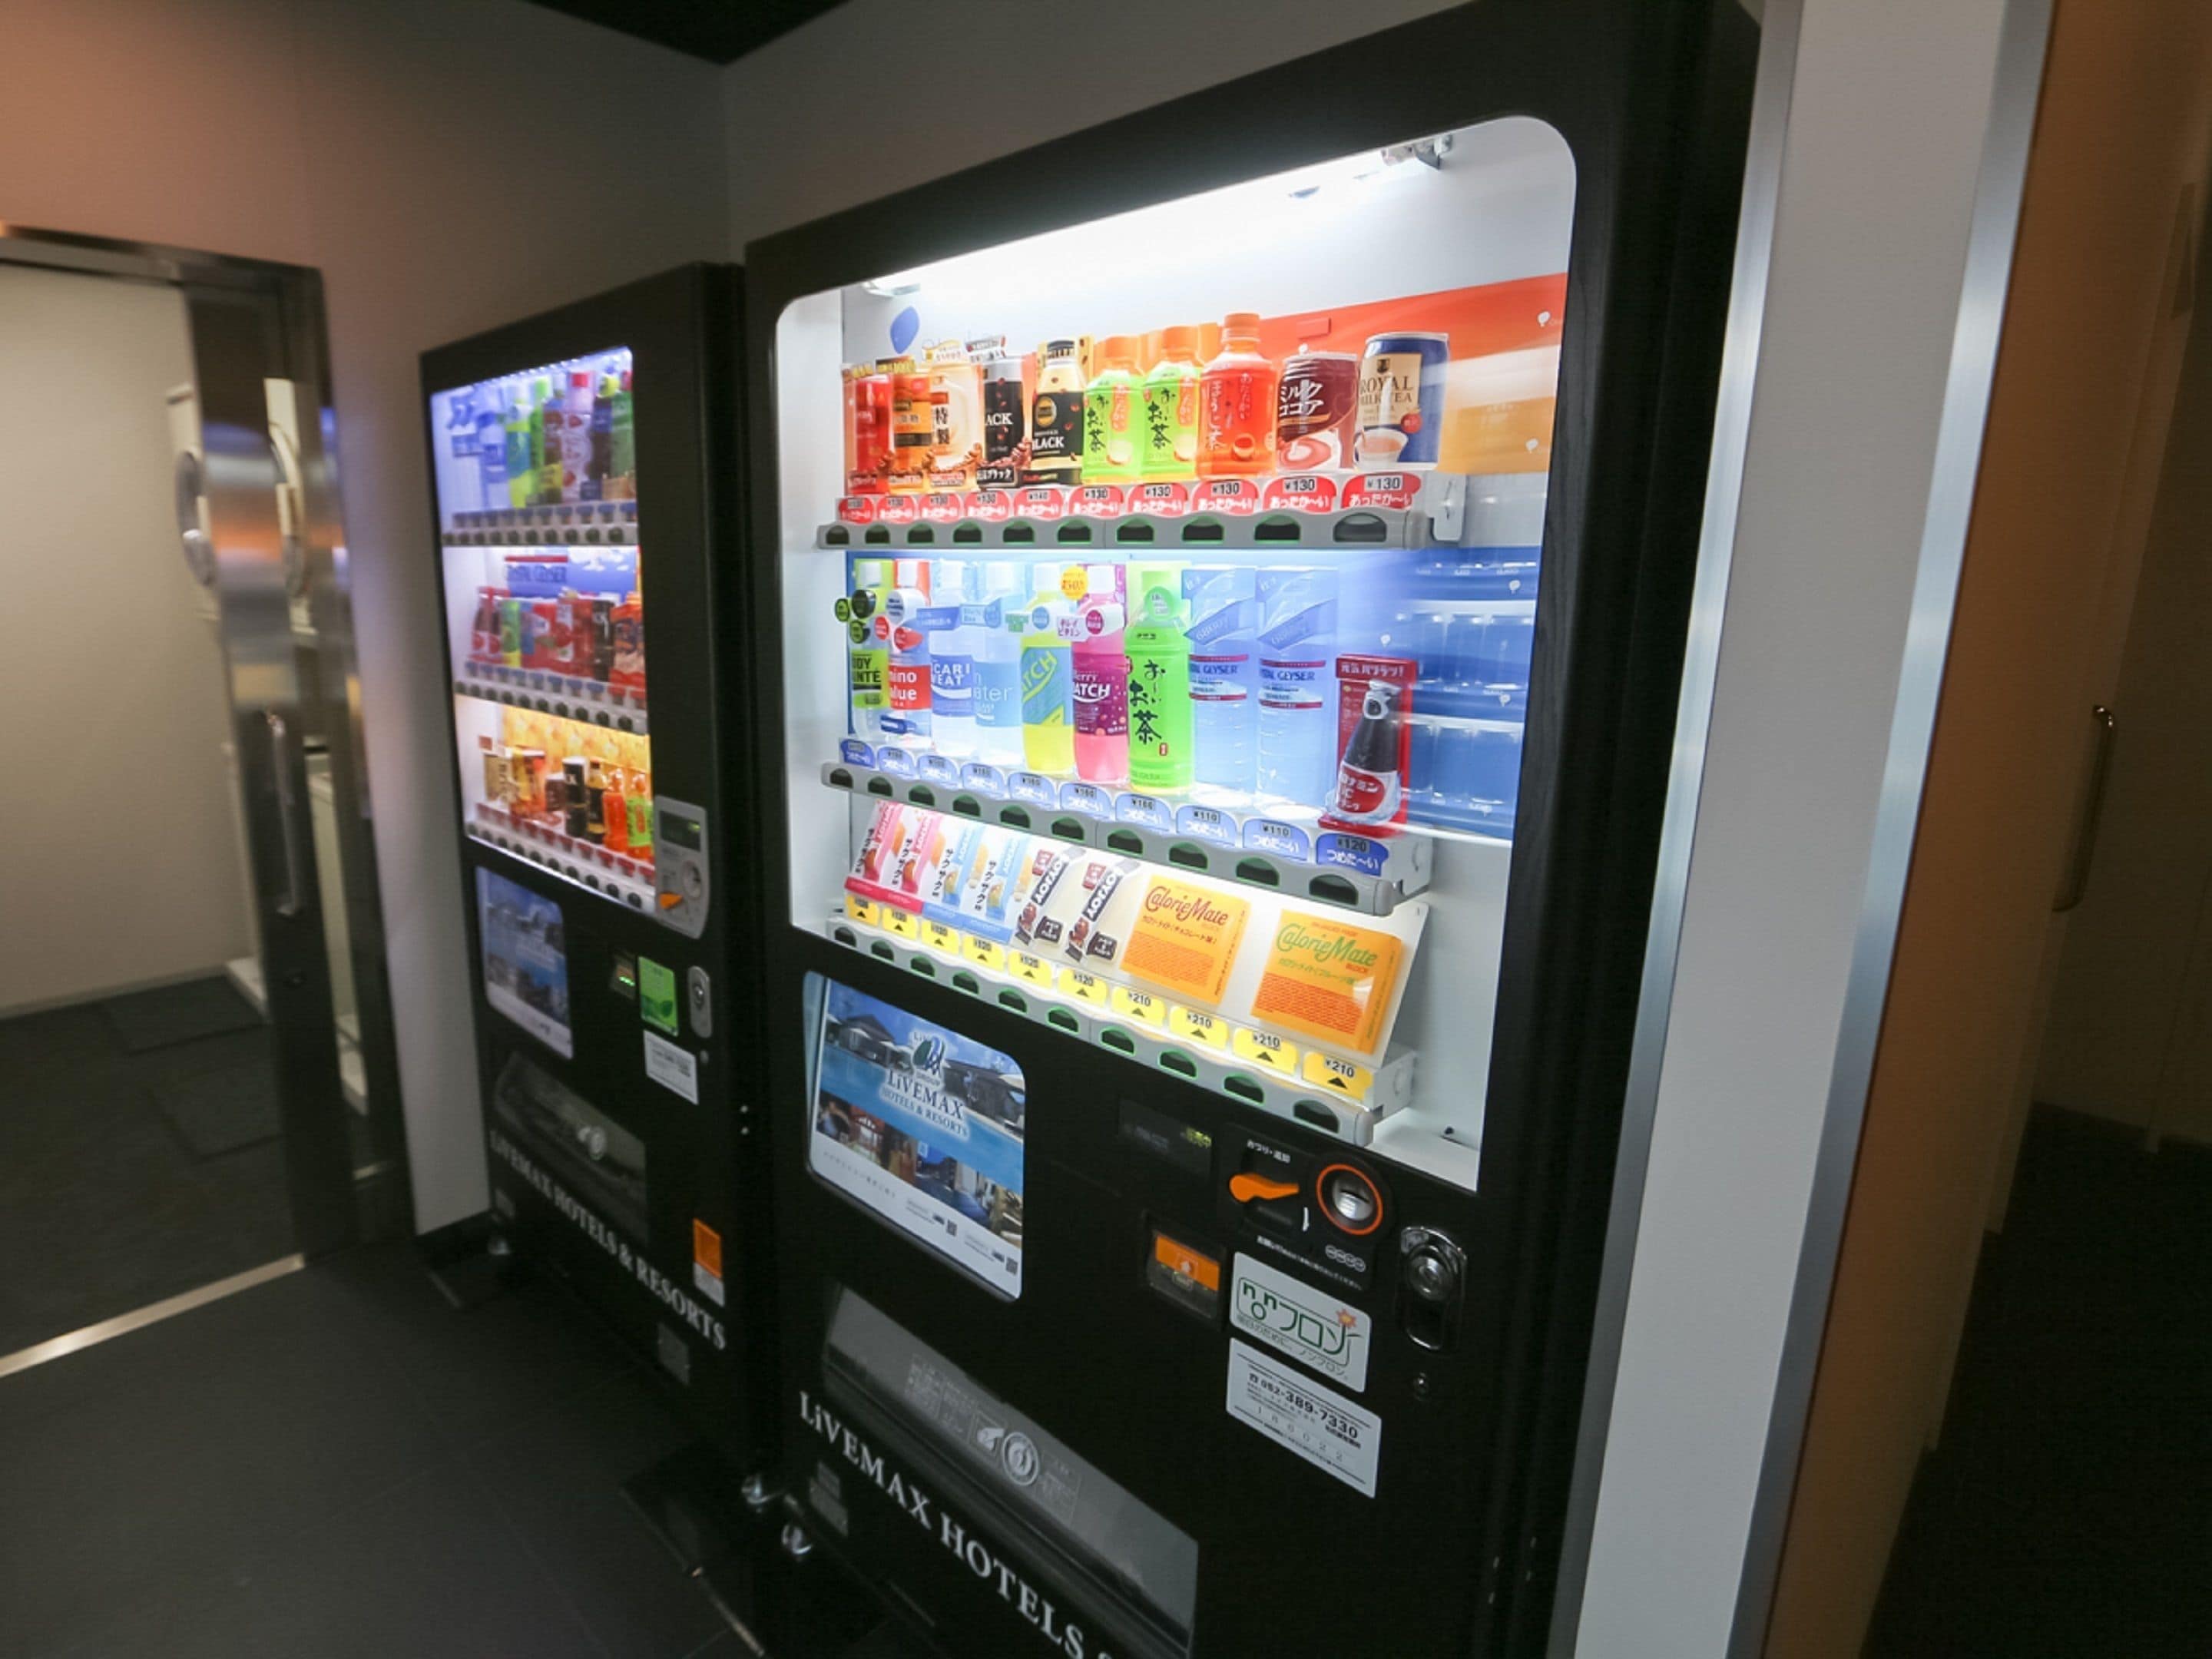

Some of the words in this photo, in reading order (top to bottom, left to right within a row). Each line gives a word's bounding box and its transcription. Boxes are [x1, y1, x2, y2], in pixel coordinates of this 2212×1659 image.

[1280, 379, 1323, 402] ミルク
[1279, 399, 1324, 417] ココア
[1277, 671, 1316, 681] GEYSER
[636, 1256, 726, 1350] RESORTS
[799, 1389, 932, 1531] LiVEMAX
[939, 1511, 1085, 1659] HOTELS
